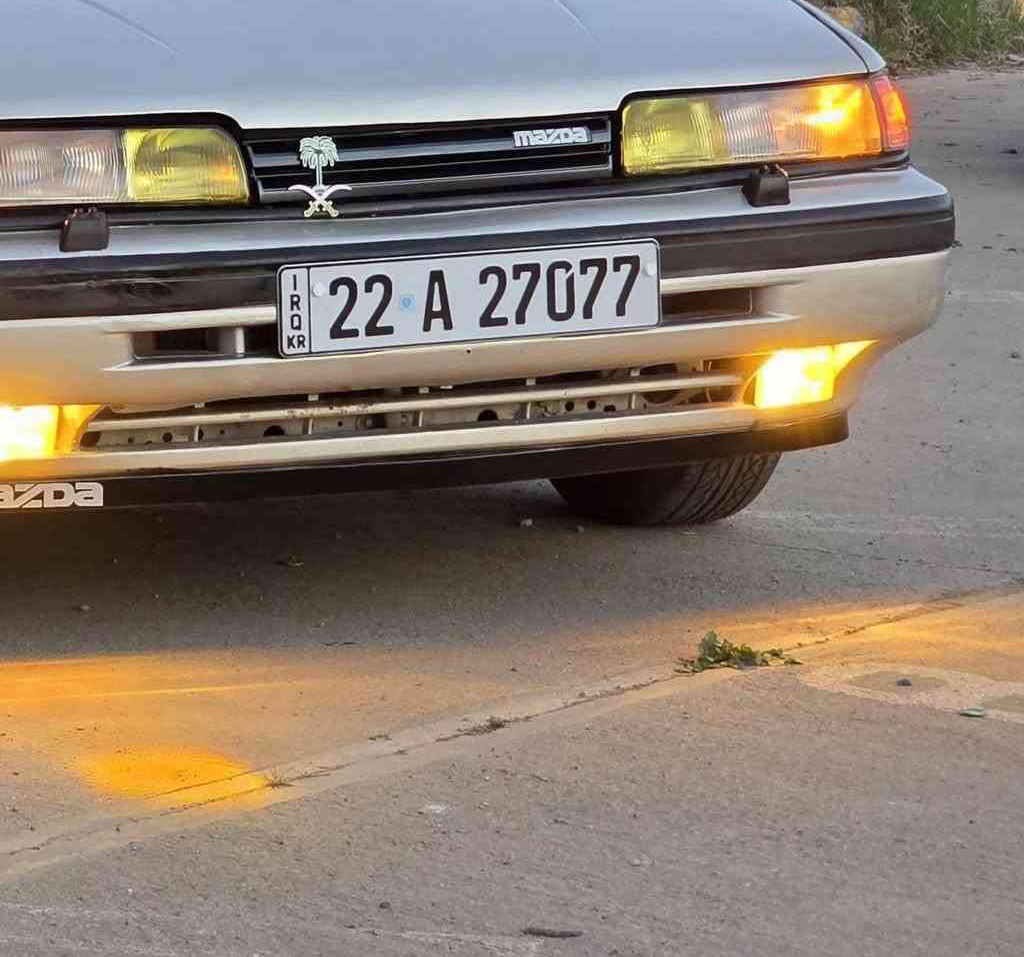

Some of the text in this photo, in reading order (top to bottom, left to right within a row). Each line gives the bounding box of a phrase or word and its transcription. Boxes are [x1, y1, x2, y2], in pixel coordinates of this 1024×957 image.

[513, 126, 589, 147] mazda
[329, 254, 641, 340] 22 A 27077
[287, 334, 306, 349] KR
